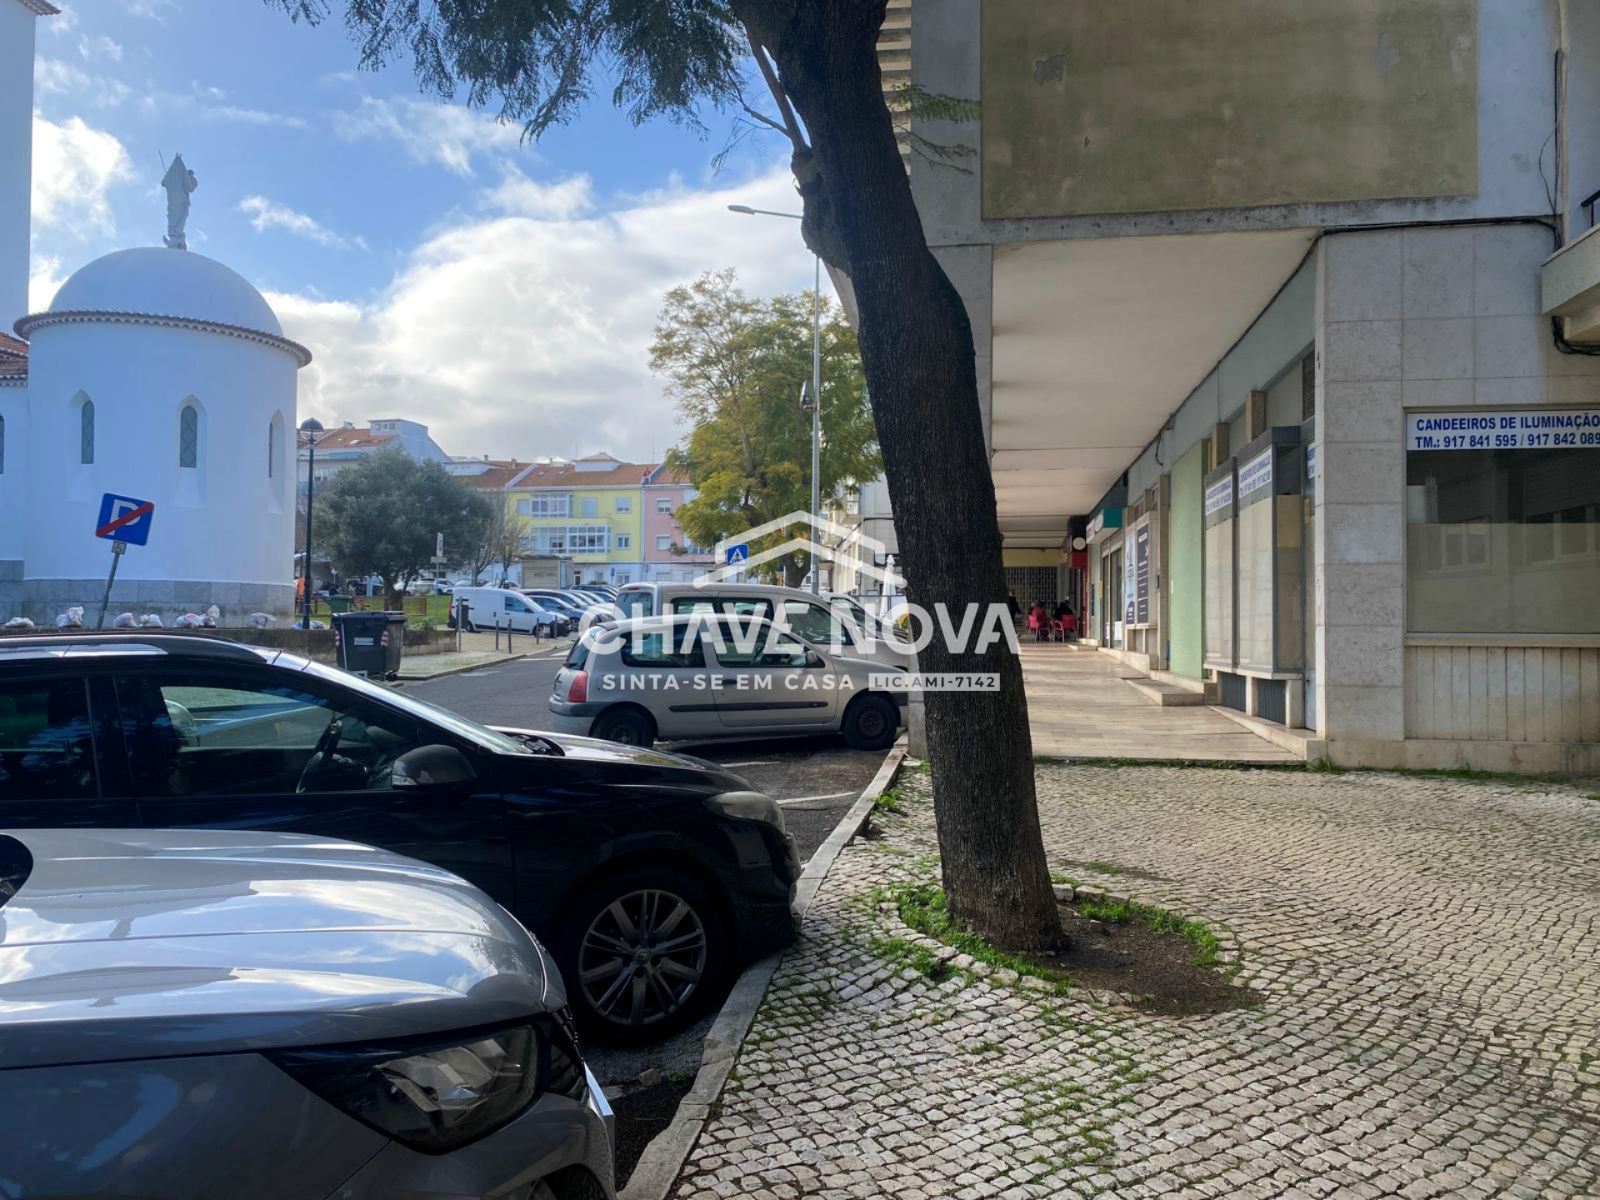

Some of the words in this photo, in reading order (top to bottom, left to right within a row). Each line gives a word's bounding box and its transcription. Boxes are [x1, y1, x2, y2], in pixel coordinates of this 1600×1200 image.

[1416, 418, 1496, 431] CANDEEIROS
[1500, 416, 1516, 429] DE
[1520, 412, 1600, 430] ILUMINAÇÃO
[1415, 436, 1440, 448] TM.:
[1444, 436, 1465, 448] 917
[1469, 435, 1490, 447] 841
[1495, 434, 1517, 446] 595
[1527, 434, 1549, 446] 917
[1554, 433, 1576, 445] 842
[1580, 432, 1600, 445] 089
